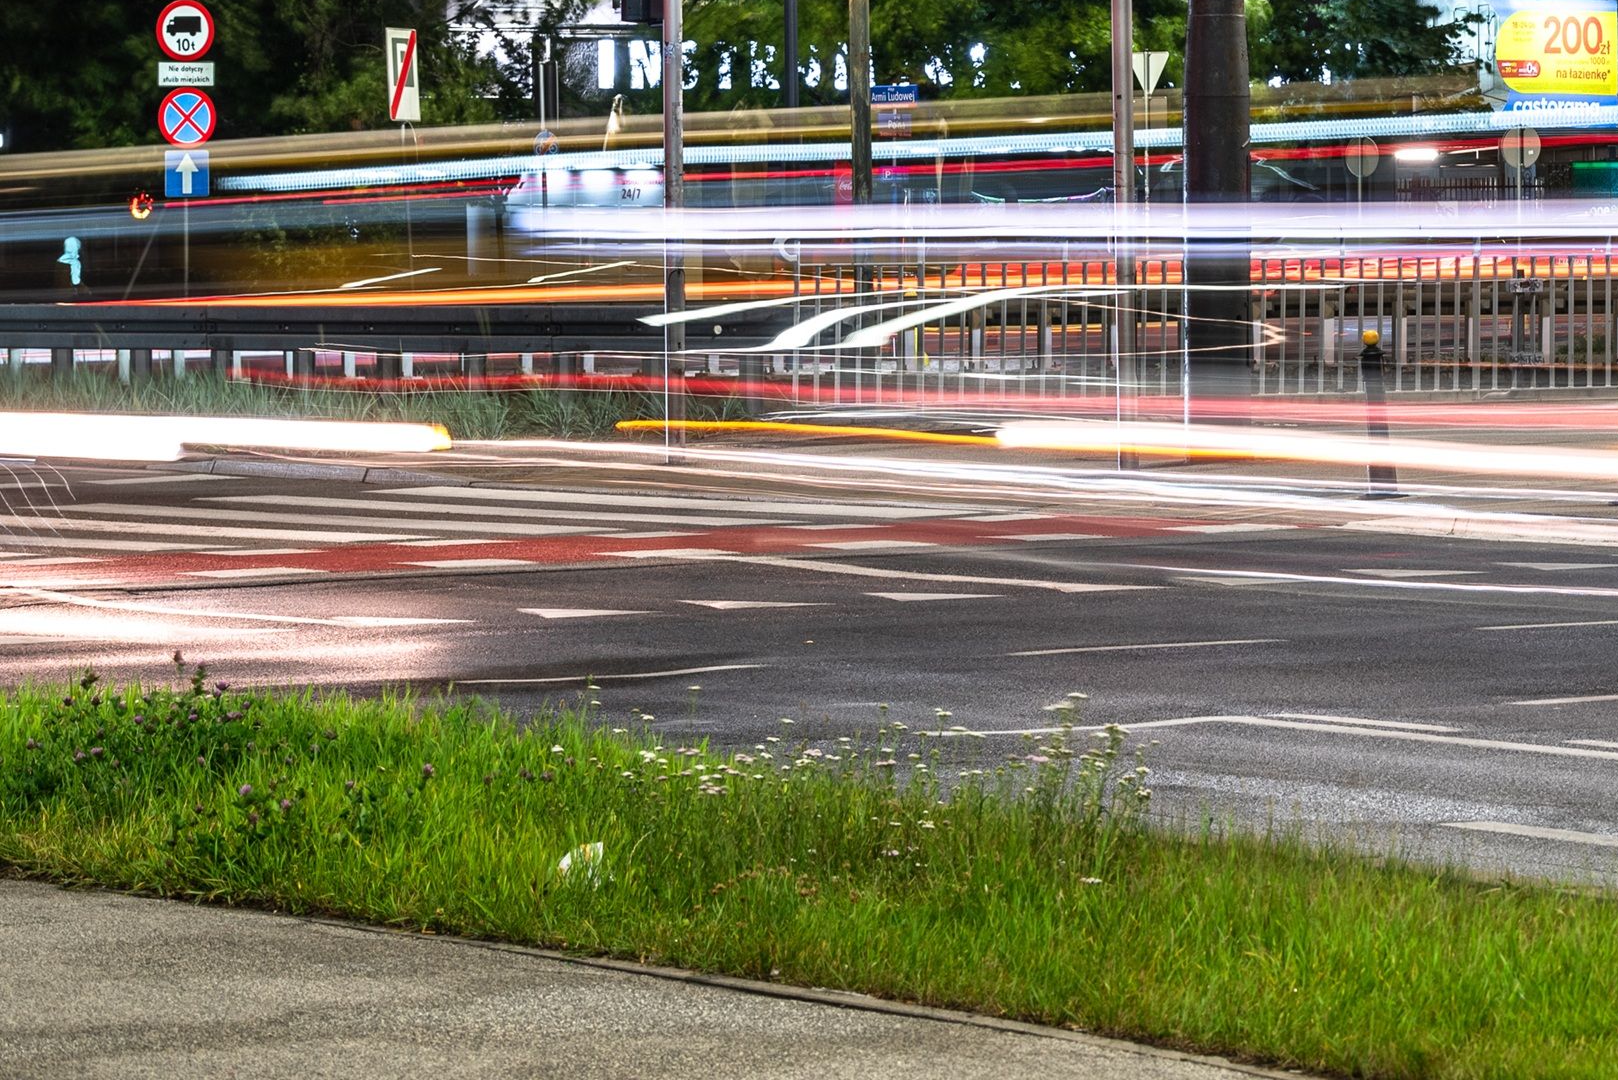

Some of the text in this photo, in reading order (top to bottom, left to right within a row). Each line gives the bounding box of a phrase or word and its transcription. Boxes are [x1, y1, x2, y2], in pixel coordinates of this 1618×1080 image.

[1543, 15, 1603, 55] 200
[1556, 69, 1567, 79] na
[871, 90, 915, 103] Armii Ludowej
[621, 188, 641, 201] 24/7
